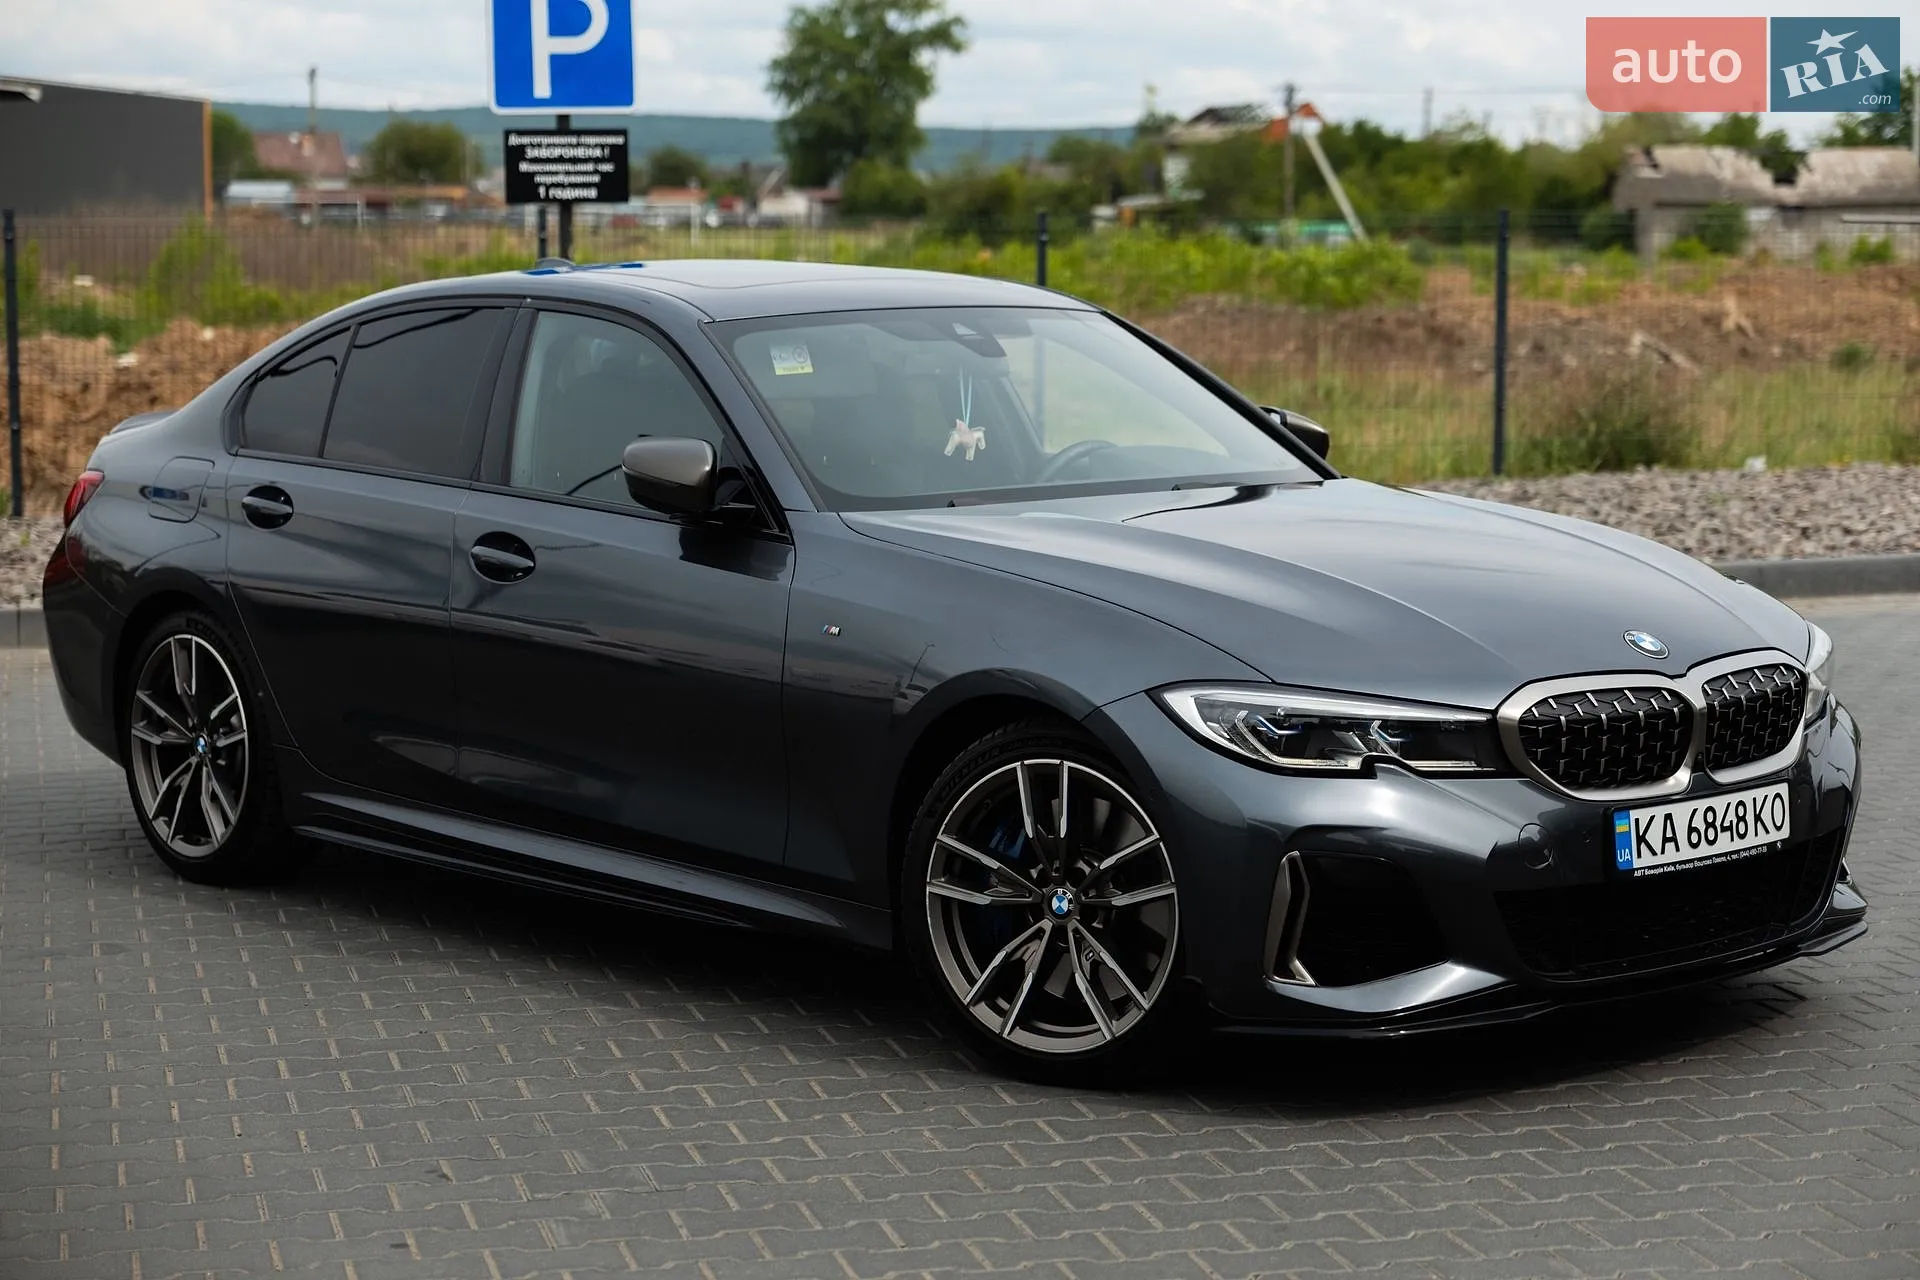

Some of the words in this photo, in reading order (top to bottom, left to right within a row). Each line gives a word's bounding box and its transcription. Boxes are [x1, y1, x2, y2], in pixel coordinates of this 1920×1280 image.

[530, 0, 609, 98] P
[524, 145, 603, 159] ЗАБОРОНЕНА
[538, 185, 546, 199] 1
[548, 186, 598, 200] година
[1634, 813, 1680, 859] KA
[1687, 800, 1748, 849] 6848
[1753, 792, 1786, 838] KO
[1617, 848, 1631, 862] UA
